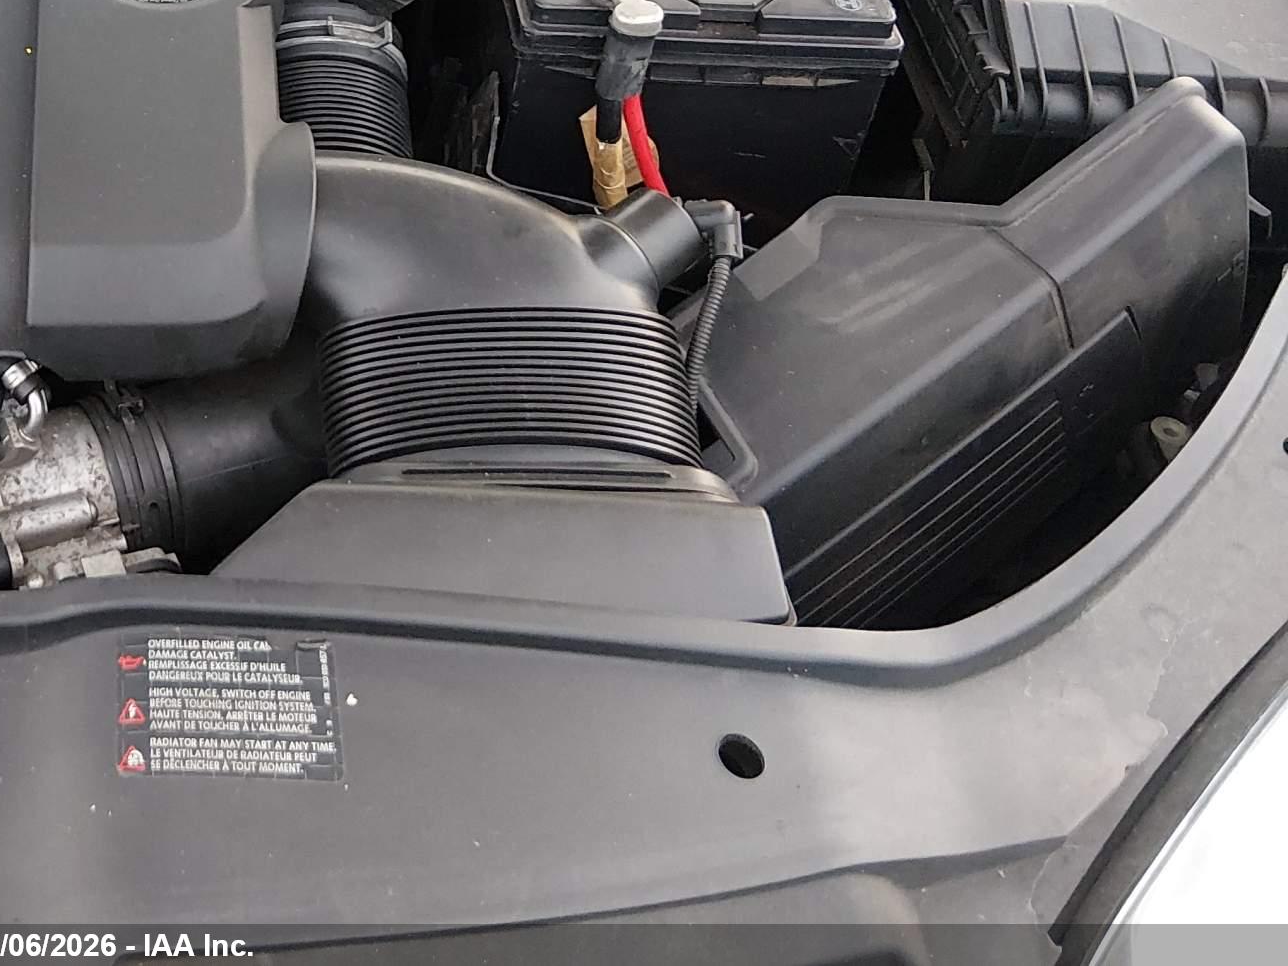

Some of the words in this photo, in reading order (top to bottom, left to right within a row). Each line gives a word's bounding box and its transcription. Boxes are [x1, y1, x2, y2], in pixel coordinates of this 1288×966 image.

[148, 639, 200, 648] OVERFILLED
[202, 640, 234, 650] ENGINE
[237, 641, 250, 650] OIL
[148, 650, 188, 659] DAMAGE
[190, 650, 236, 660] CATALYST.
[148, 660, 207, 670] REMPLISSAGE
[211, 661, 248, 671] EXCESSIF
[250, 662, 286, 672] D'HUILE
[149, 671, 203, 681] DANGEREUX
[206, 672, 230, 682] POUR
[233, 673, 242, 682] LE
[244, 673, 303, 684] CATALYSEUR.
[149, 687, 172, 697] HIGH
[222, 689, 256, 699] SWITCH
[258, 690, 276, 699] OFF
[278, 690, 310, 700] ENGINE
[150, 698, 182, 708] BEFORE
[184, 699, 232, 710] TOUCHING
[235, 700, 276, 711] IGNITION
[150, 710, 180, 719] HAUTE
[266, 712, 276, 722] LE
[278, 713, 318, 724] MOTEUR
[150, 720, 182, 730] AVANT
[184, 721, 196, 730] DE
[198, 721, 240, 731] TOUCHER
[150, 738, 196, 747] RADIATOR
[199, 738, 217, 747] FAN
[220, 738, 242, 748] MAY
[245, 739, 272, 750] START
[274, 740, 288, 750] AT
[289, 740, 308, 751] ANY
[312, 741, 337, 752] TIME.
[150, 748, 160, 758] LE
[164, 748, 224, 758] VENTILATEUR
[226, 750, 238, 760] DE
[240, 750, 292, 761] RADIATEUR
[294, 752, 317, 762] PEUT
[150, 759, 160, 770] SE
[232, 761, 256, 771] TOUT
[258, 762, 304, 773] MOMENT.
